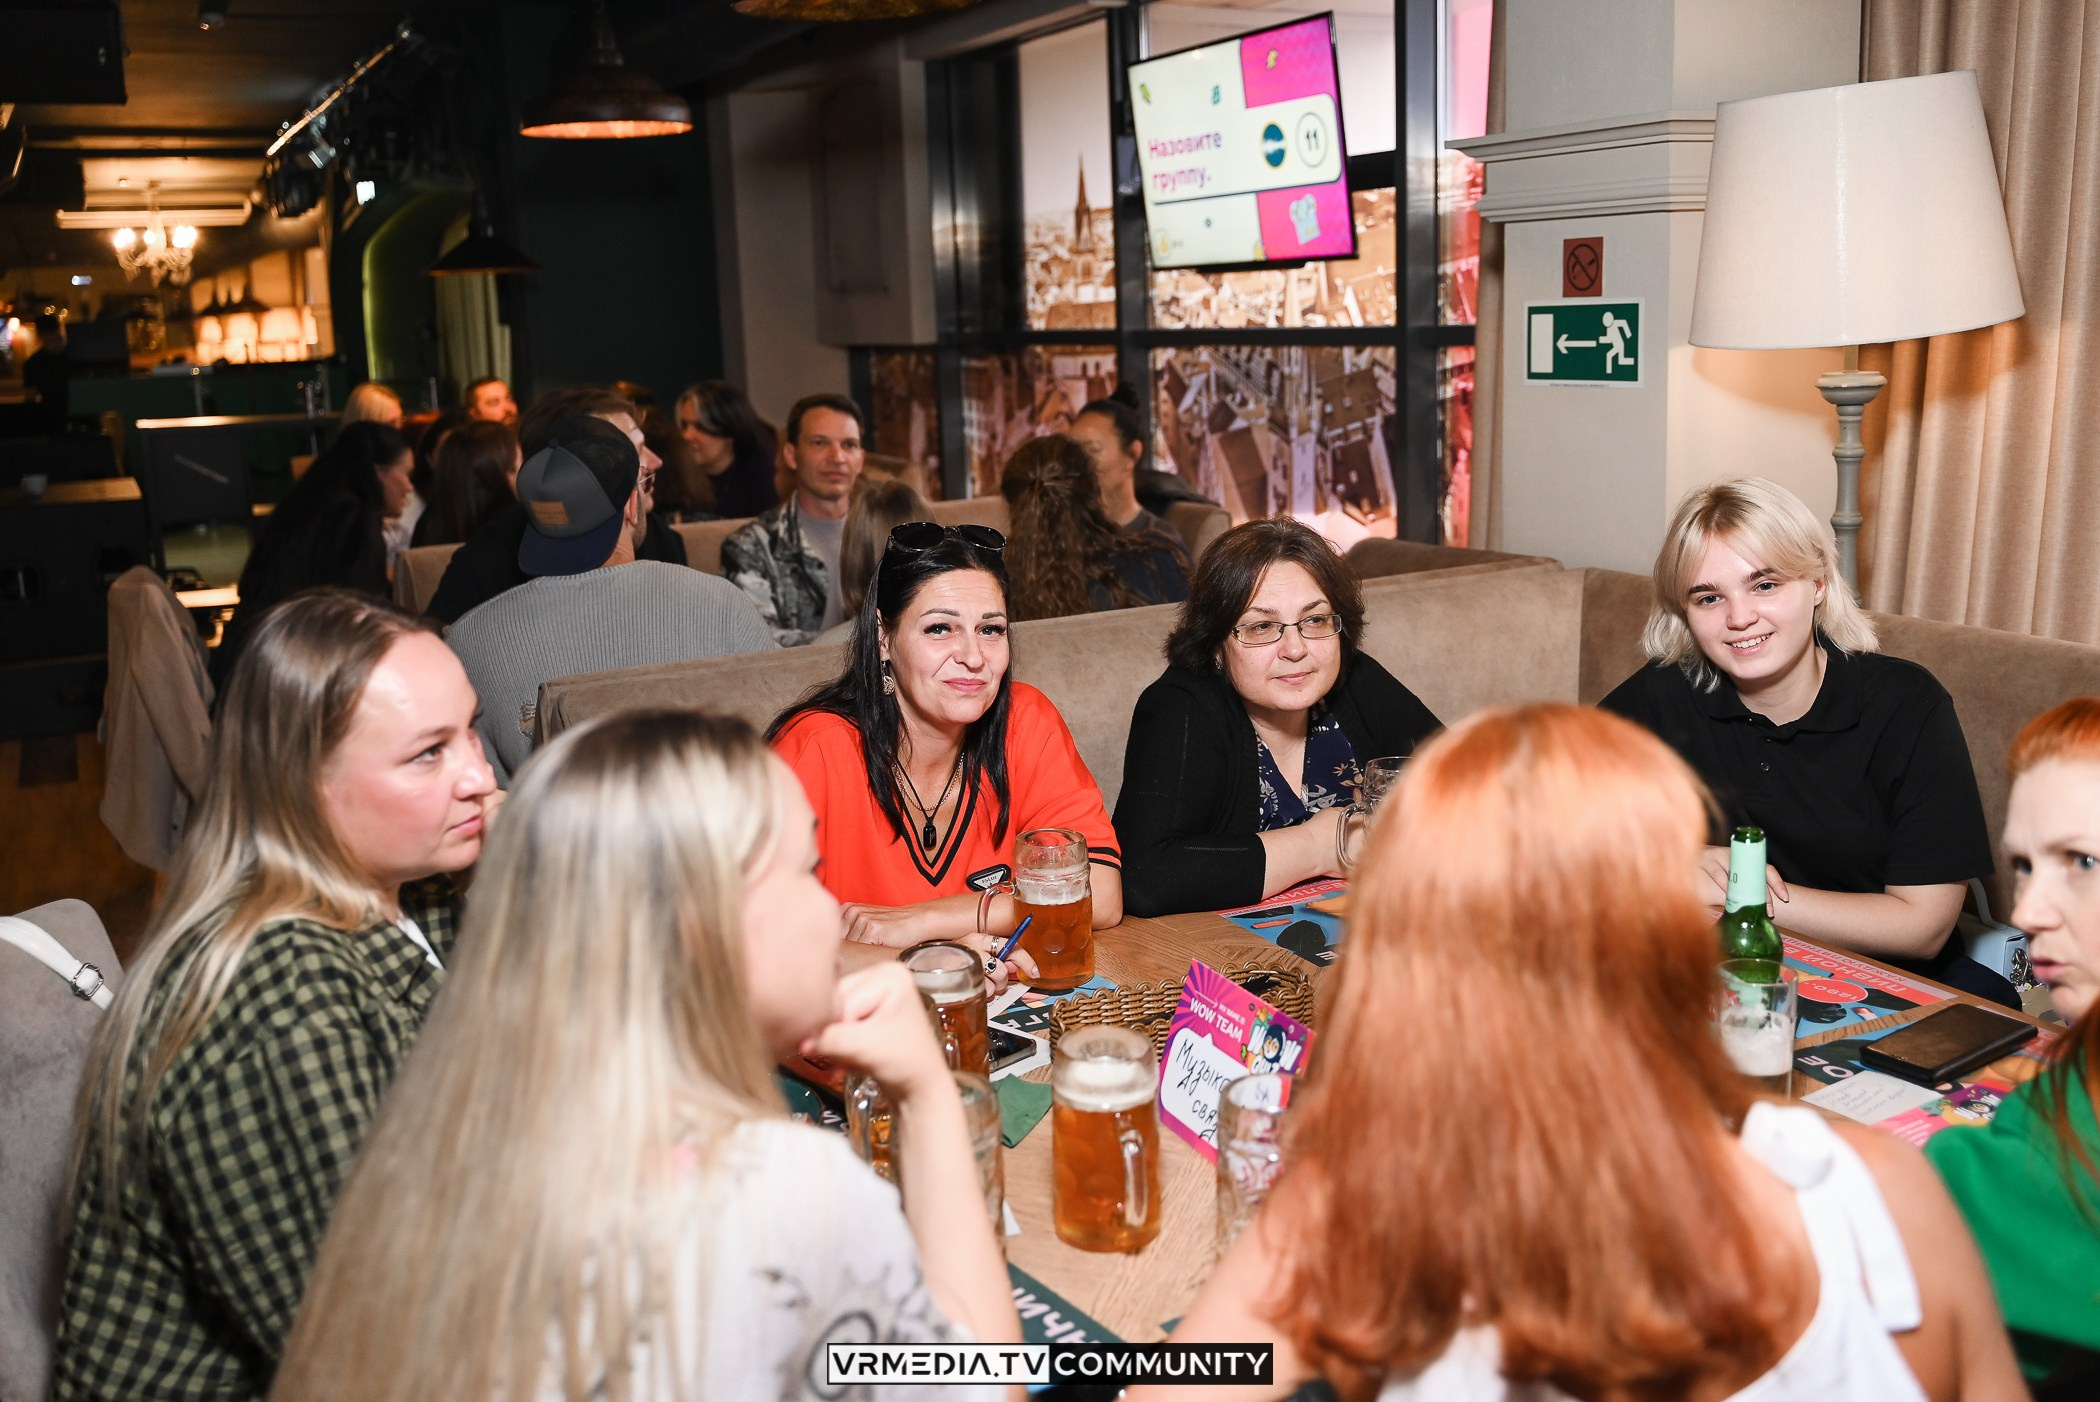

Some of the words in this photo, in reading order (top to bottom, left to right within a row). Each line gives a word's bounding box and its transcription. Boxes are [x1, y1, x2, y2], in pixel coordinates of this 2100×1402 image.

[1148, 132, 1222, 158] Назовите
[1153, 168, 1212, 193] группу.
[1802, 953, 1908, 993] ПИВНОЙ
[1190, 998, 1217, 1025] WOW
[1215, 1014, 1244, 1043] TEAM
